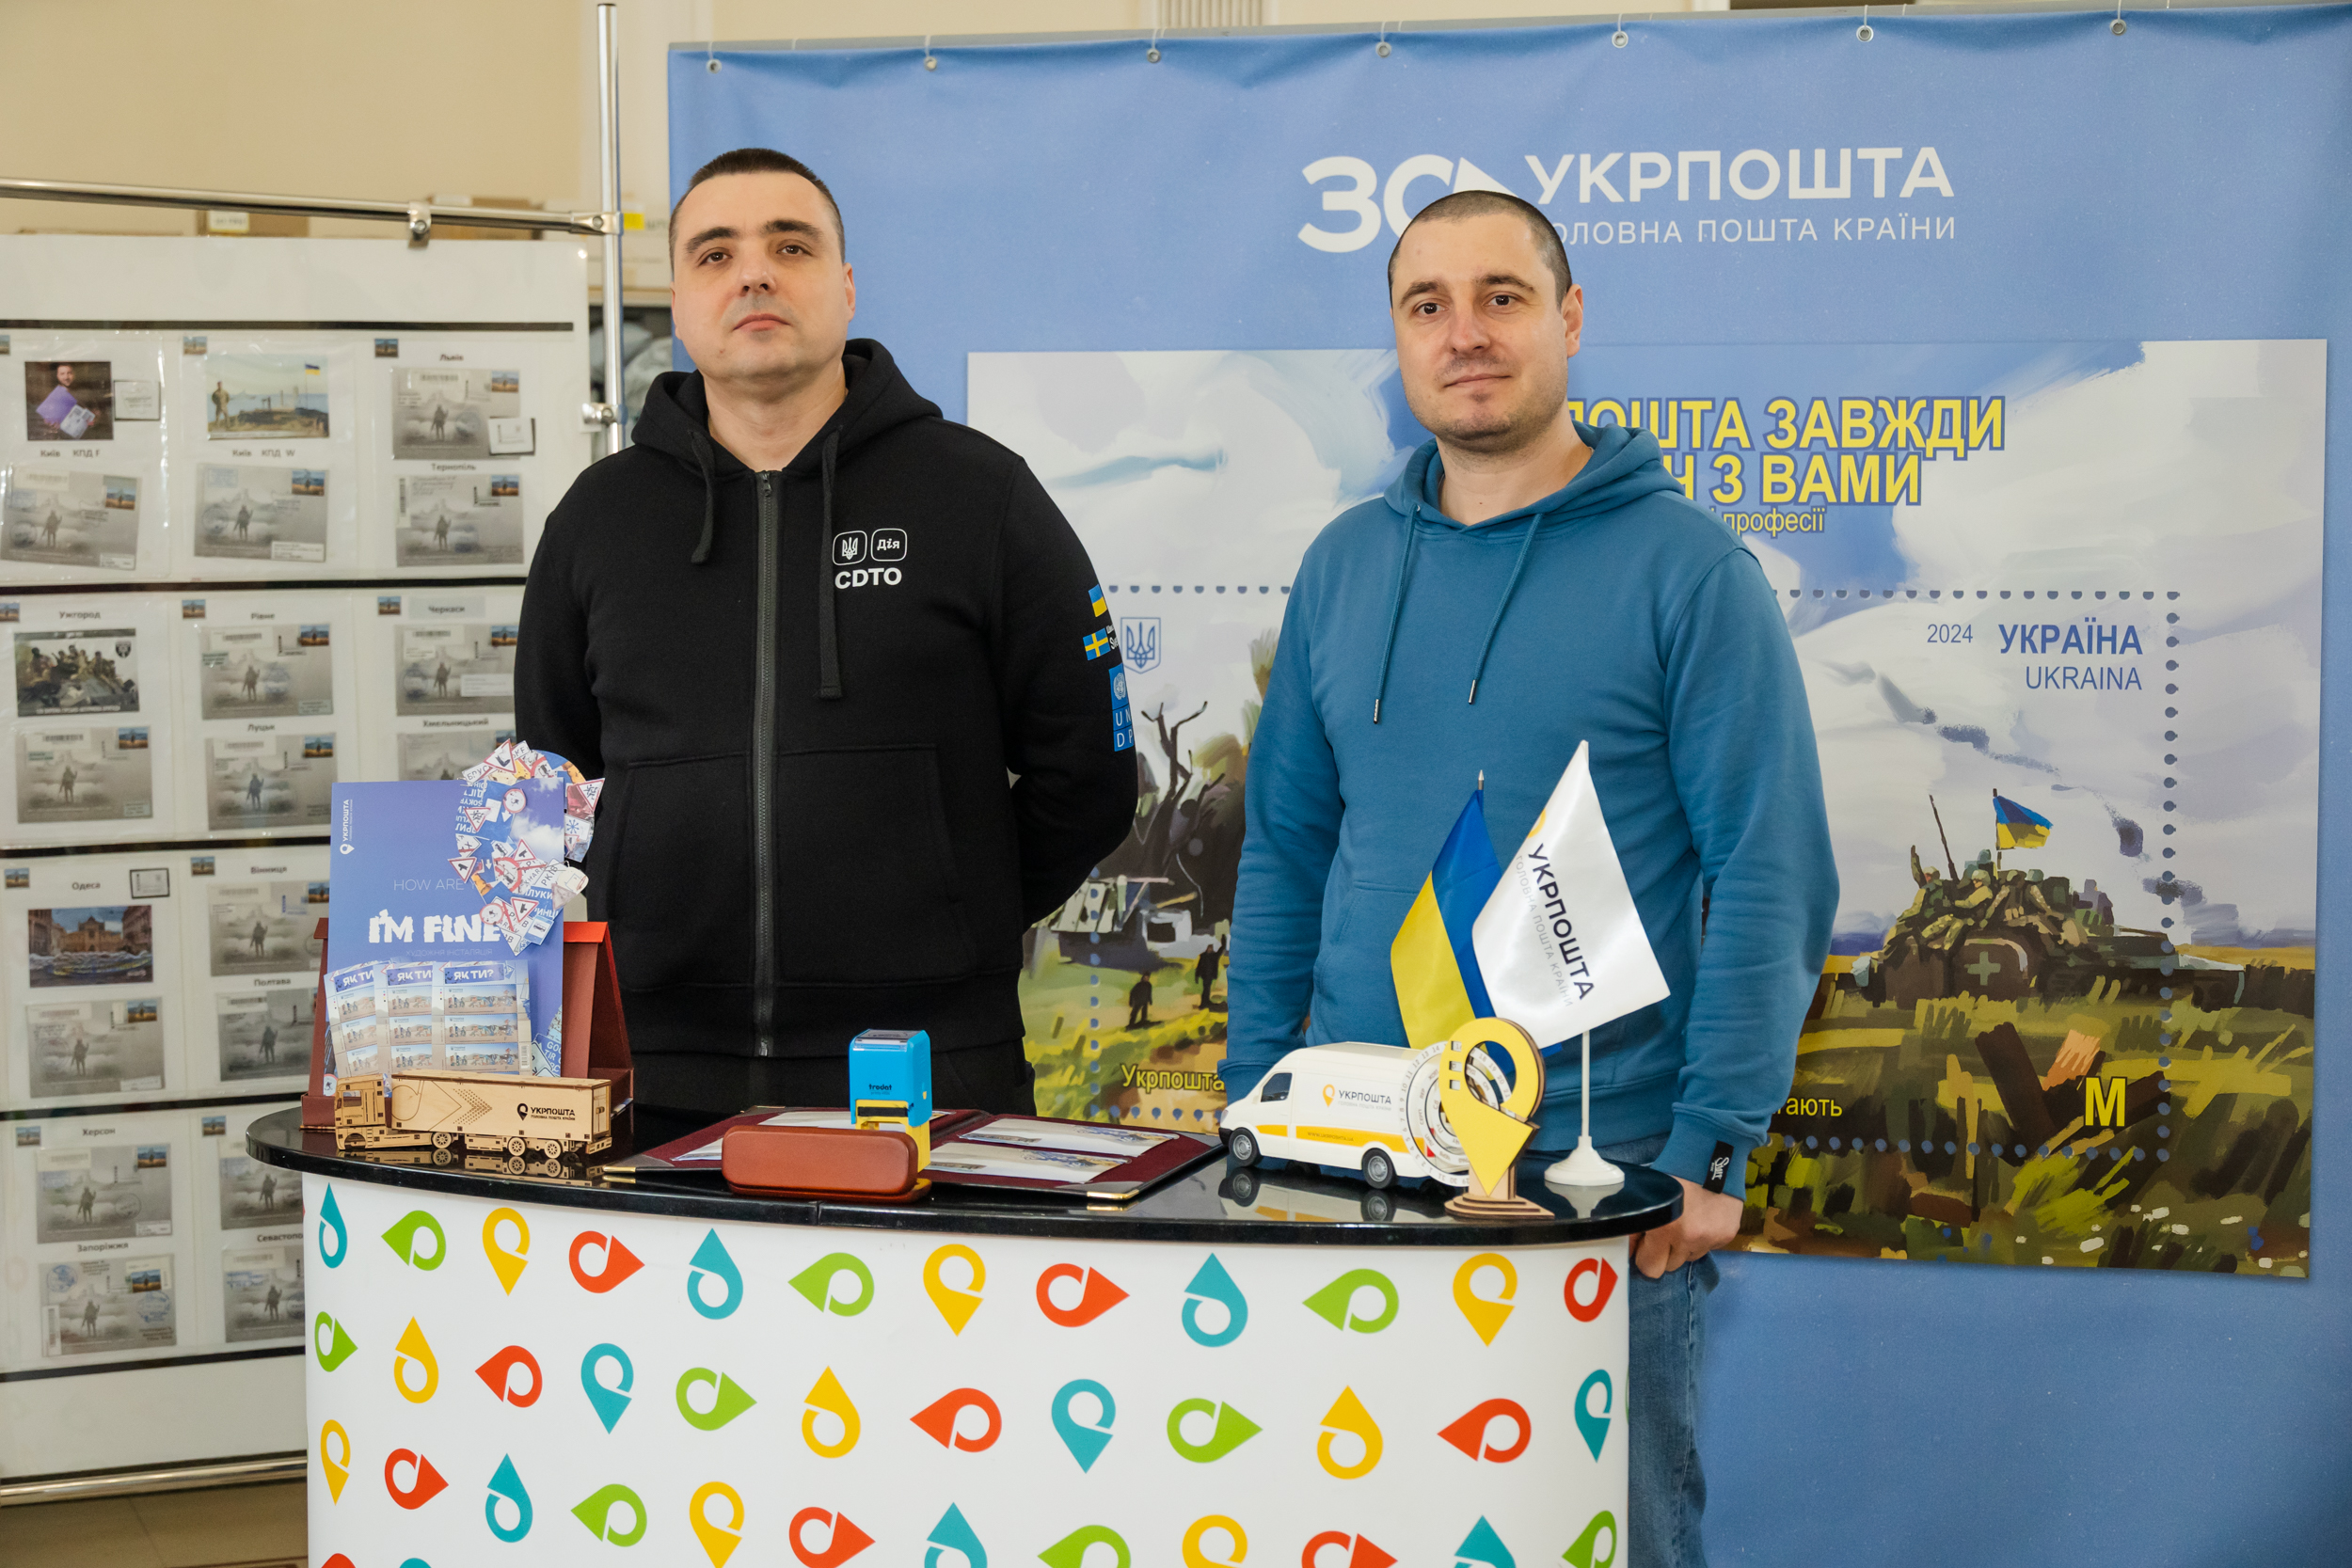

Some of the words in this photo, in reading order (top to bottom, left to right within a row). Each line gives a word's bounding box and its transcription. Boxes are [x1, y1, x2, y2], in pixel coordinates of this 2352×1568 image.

[1524, 147, 1955, 204] УКРПОШТА
[1553, 221, 1682, 245] ОЛОВНА
[1697, 218, 1818, 243] ПОШТА
[1834, 213, 1955, 240] КРАЇНИ
[1766, 399, 2004, 459] ЗАВЖДИ
[40, 450, 61, 458] Київ
[72, 450, 93, 458] КПД
[262, 449, 281, 458] КПД
[432, 463, 476, 471] Тернопіль
[1712, 454, 1742, 503] З
[1762, 454, 1920, 503] ВАМИ
[1723, 507, 1826, 537] професії
[877, 538, 900, 551] Дія
[834, 567, 902, 589] CDTO
[59, 610, 101, 620] Ужгород
[428, 606, 465, 614] Черкаси
[1927, 623, 1973, 644] 2024
[1999, 617, 2143, 656] УКРАЇНА
[2025, 666, 2143, 690] UKRAINA
[422, 718, 489, 728] Хмельницький
[250, 864, 287, 875] Вінниця
[72, 880, 101, 891] Одеса
[393, 879, 431, 891] HOW
[436, 879, 465, 890] ARE
[1528, 843, 1595, 1001] УКРПОШТА
[1516, 855, 1537, 912] ГОЛОВНА
[1533, 915, 1555, 960] ПОШТА
[1549, 962, 1573, 1006] КРАЇНИ
[397, 971, 413, 981] ЯК
[415, 970, 433, 979] ТИ
[453, 972, 469, 980] ЯК
[470, 970, 494, 979] ТИ?
[254, 977, 292, 987] Полтава
[1120, 1064, 1225, 1094] Укрпошта
[1339, 1090, 1391, 1104] УКРПОШТА
[531, 1107, 575, 1117] УКРПОШТА
[83, 1127, 115, 1137] Херсон
[257, 1231, 303, 1243] Севастопо
[77, 1242, 129, 1253] Запоріжжя
